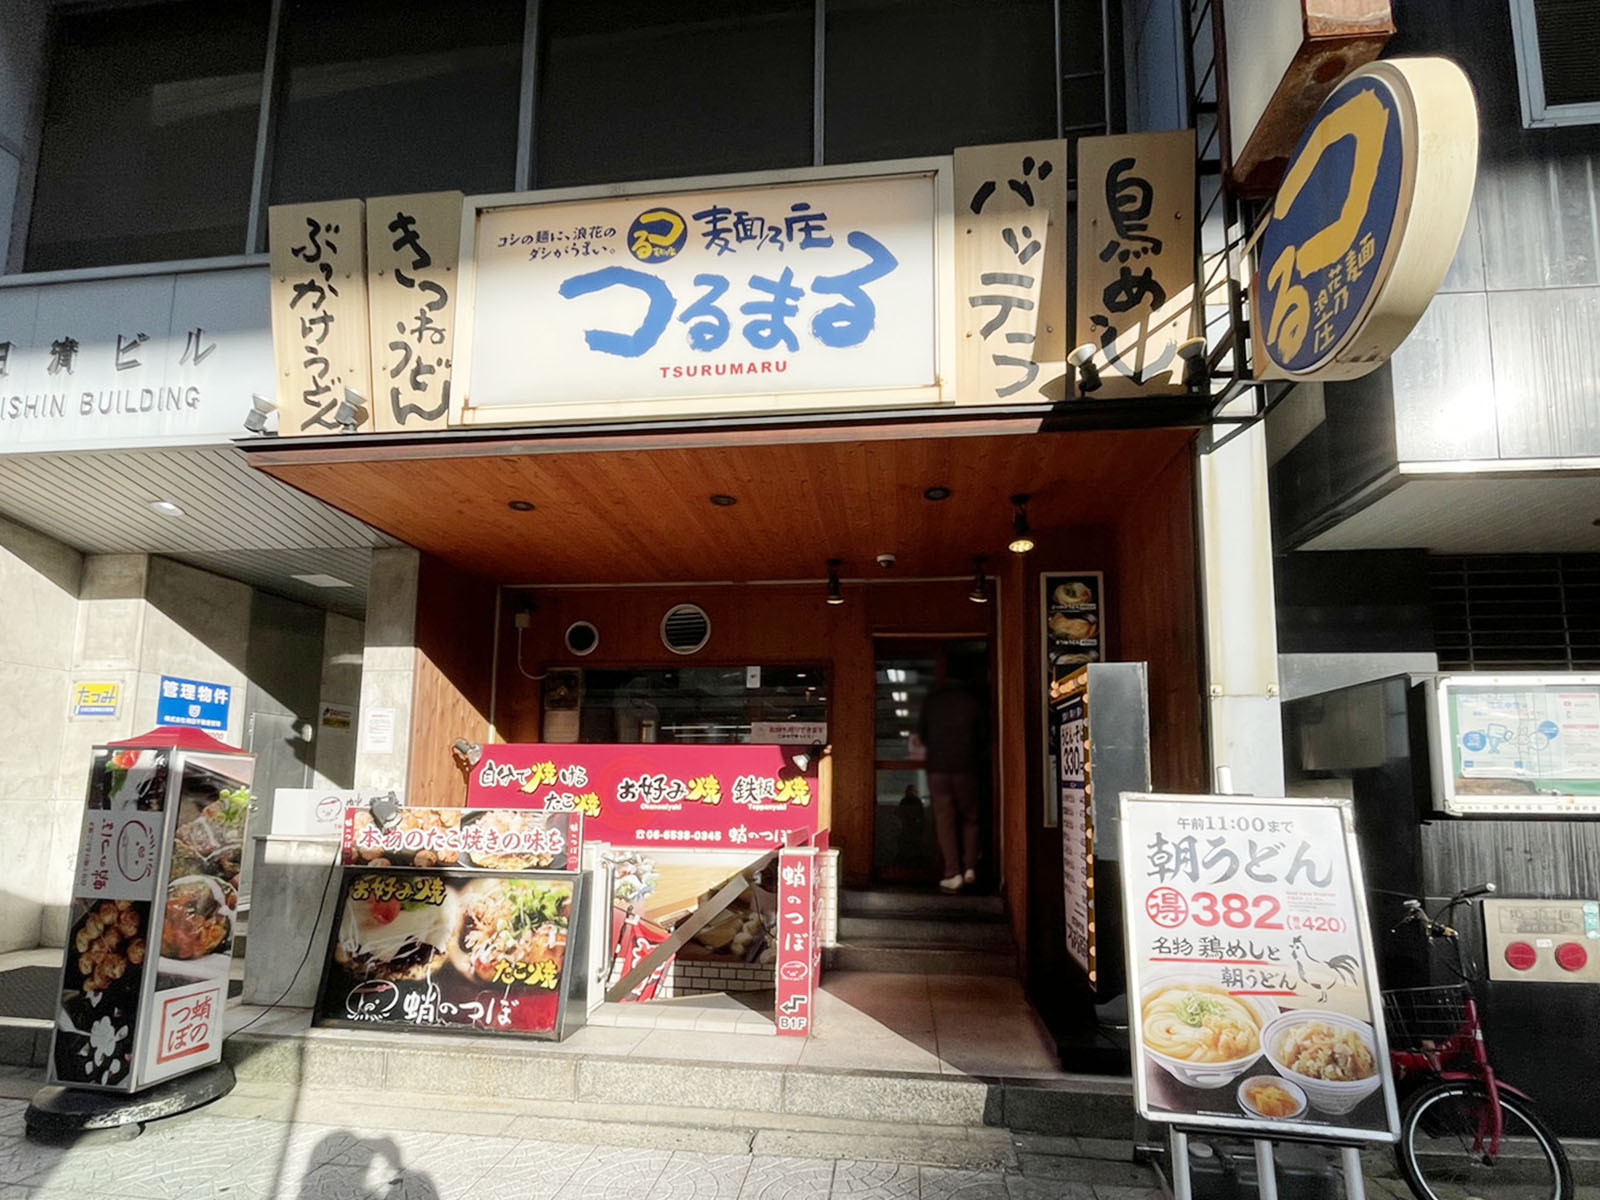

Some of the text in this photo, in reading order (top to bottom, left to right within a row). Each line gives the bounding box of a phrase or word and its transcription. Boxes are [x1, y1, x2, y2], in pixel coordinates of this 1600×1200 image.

[969, 156, 1054, 399] バッテラ
[1090, 157, 1178, 385] 鳥めし
[558, 231, 899, 358] つるまる
[290, 217, 342, 431] ぶっかけうどん
[388, 211, 452, 426] きつねうどん
[660, 361, 788, 379] TSURUMARU
[79, 386, 201, 416] BUILDING
[77, 685, 116, 705] たつみ
[162, 680, 229, 705] 管理物件
[544, 790, 602, 818] たこ焼
[617, 774, 723, 805] お好み焼
[732, 775, 812, 806] 鉄板焼
[358, 826, 564, 854] 本物のたこ焼きの味を
[1177, 816, 1294, 834] 午前11:00まで
[1146, 832, 1334, 888] 朝うどん
[352, 876, 447, 905] お好み焼
[781, 861, 809, 951] 蛸のつぼ
[1190, 891, 1284, 931] 382
[1152, 937, 1194, 956] 名物
[493, 959, 559, 990] たこ焼
[1221, 967, 1297, 991] 朝うどん
[403, 990, 520, 1025] 蛸のつぼ
[779, 1017, 807, 1030] B1F
